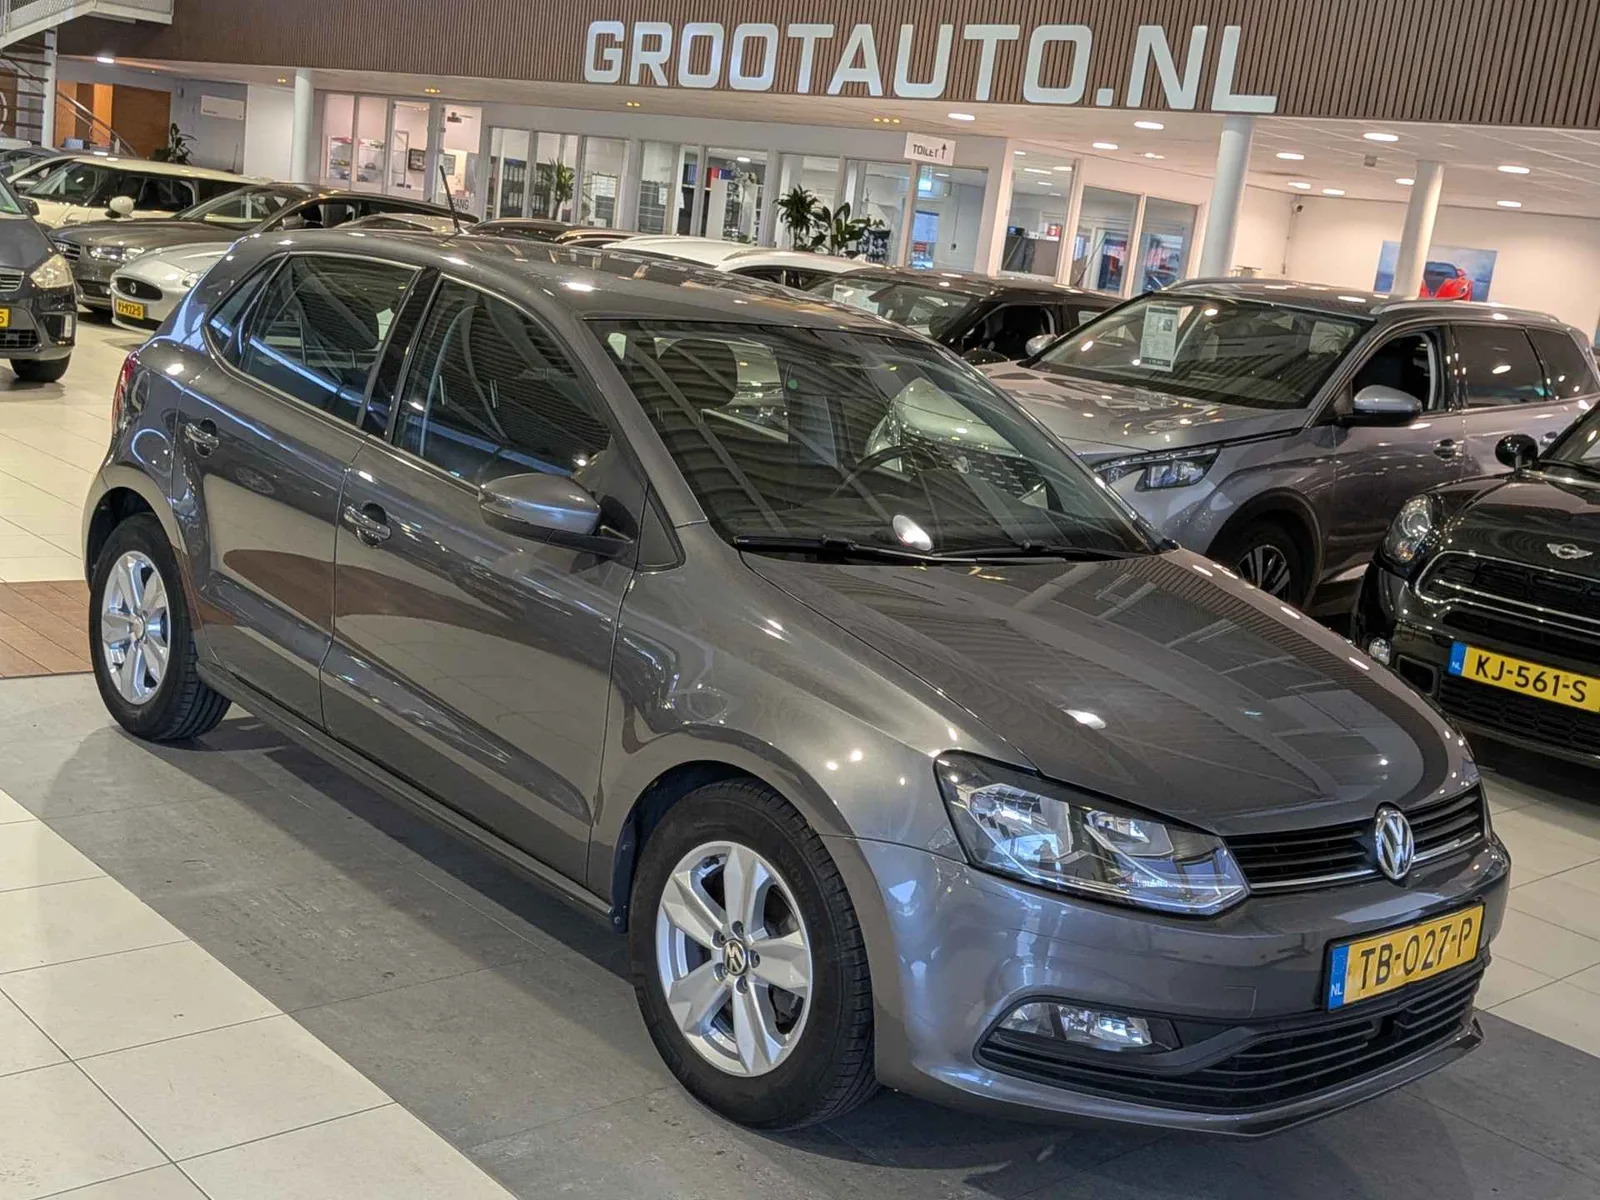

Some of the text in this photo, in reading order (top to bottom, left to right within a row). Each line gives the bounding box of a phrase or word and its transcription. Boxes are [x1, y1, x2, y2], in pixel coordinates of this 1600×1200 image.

[584, 20, 1277, 114] GROOTAUTO.NL
[913, 144, 939, 158] TOILET
[1452, 655, 1587, 703] NL KJ-561-S
[1331, 917, 1472, 996] NL TB-027-P
